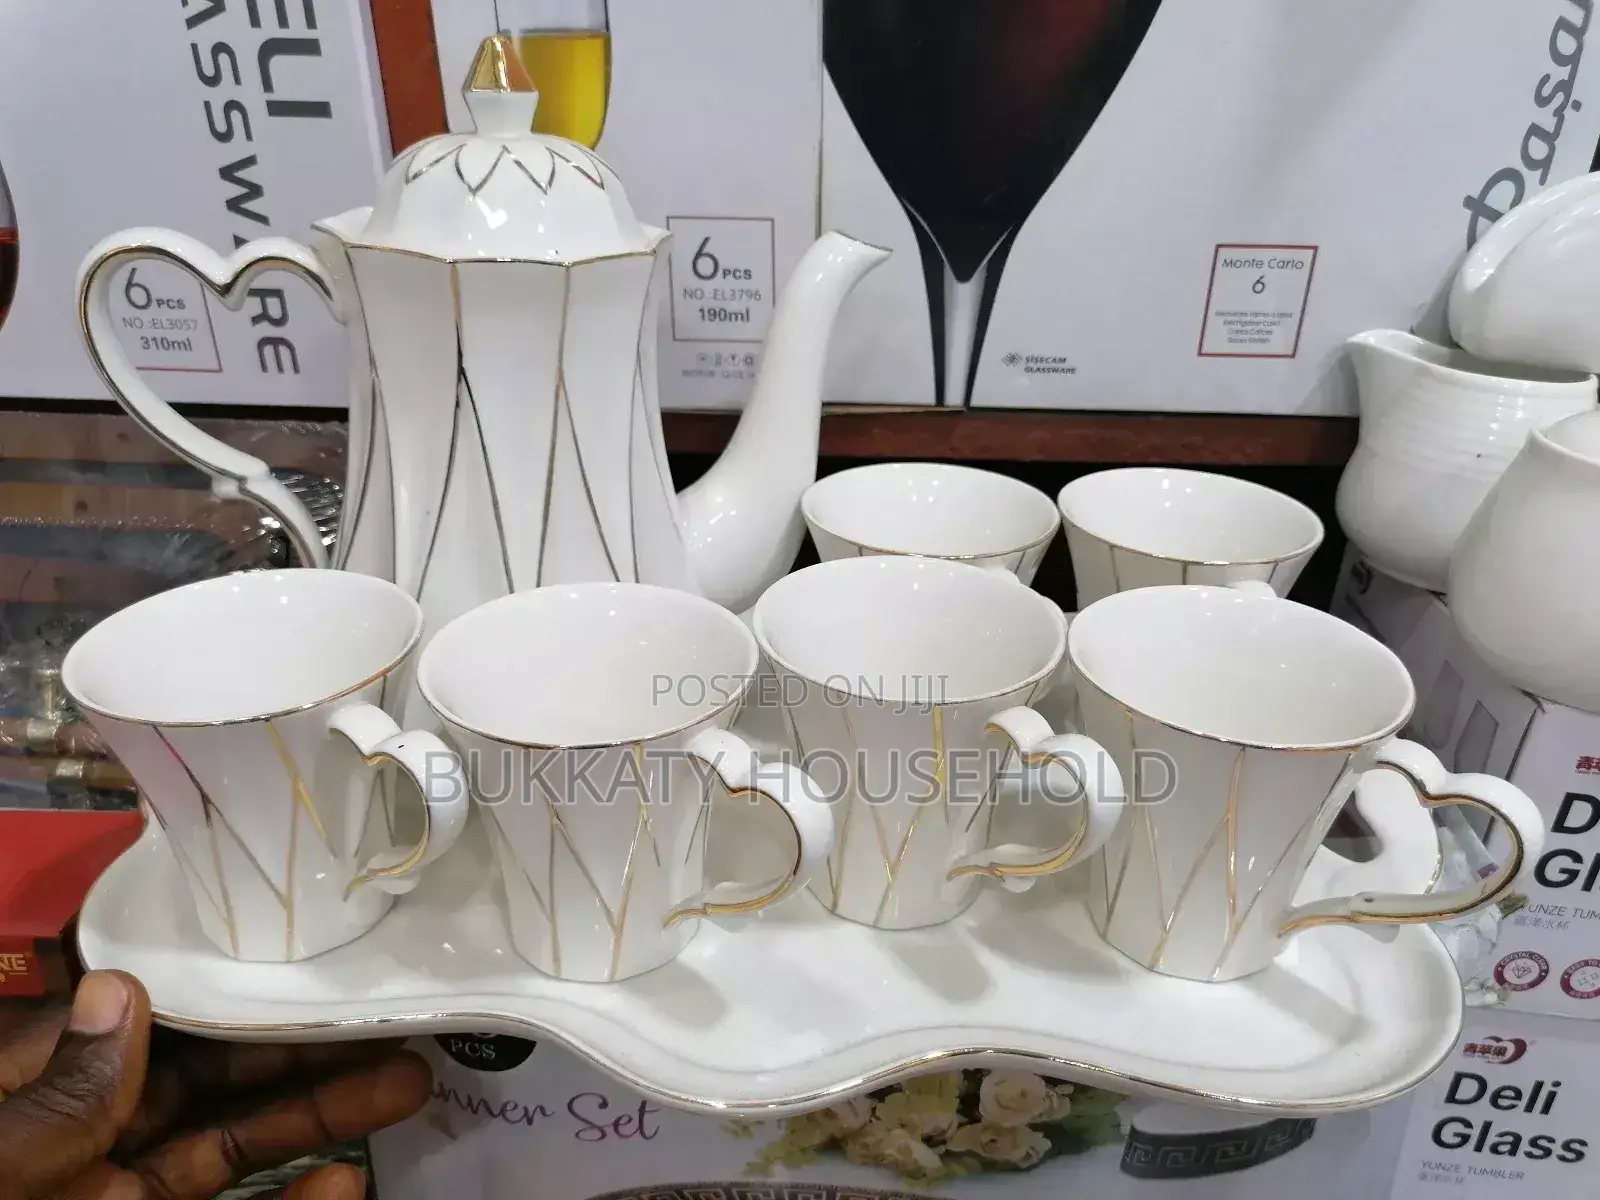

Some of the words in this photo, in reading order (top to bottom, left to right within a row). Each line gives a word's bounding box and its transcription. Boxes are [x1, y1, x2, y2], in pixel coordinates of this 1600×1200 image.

[181, 0, 301, 374] ASSWRE
[692, 236, 720, 281] 6
[722, 268, 753, 280] PCS
[1222, 257, 1264, 269] Monte
[1268, 257, 1304, 270] Carlo
[125, 267, 153, 310] 6
[156, 298, 186, 310] PCS
[1252, 274, 1266, 294] 6
[698, 307, 750, 323] 190ml
[140, 336, 193, 352] 310ml
[1024, 366, 1077, 375] GLASSWARE
[1520, 902, 1568, 917] UNZE
[450, 1038, 496, 1059] PCS
[1444, 1070, 1562, 1115] Deli
[430, 1081, 555, 1126] nner
[567, 1092, 659, 1142] Set
[1431, 1116, 1589, 1163] Glass
[1421, 1161, 1462, 1173] YUNZE
[1467, 1165, 1525, 1181] TUMBLER
